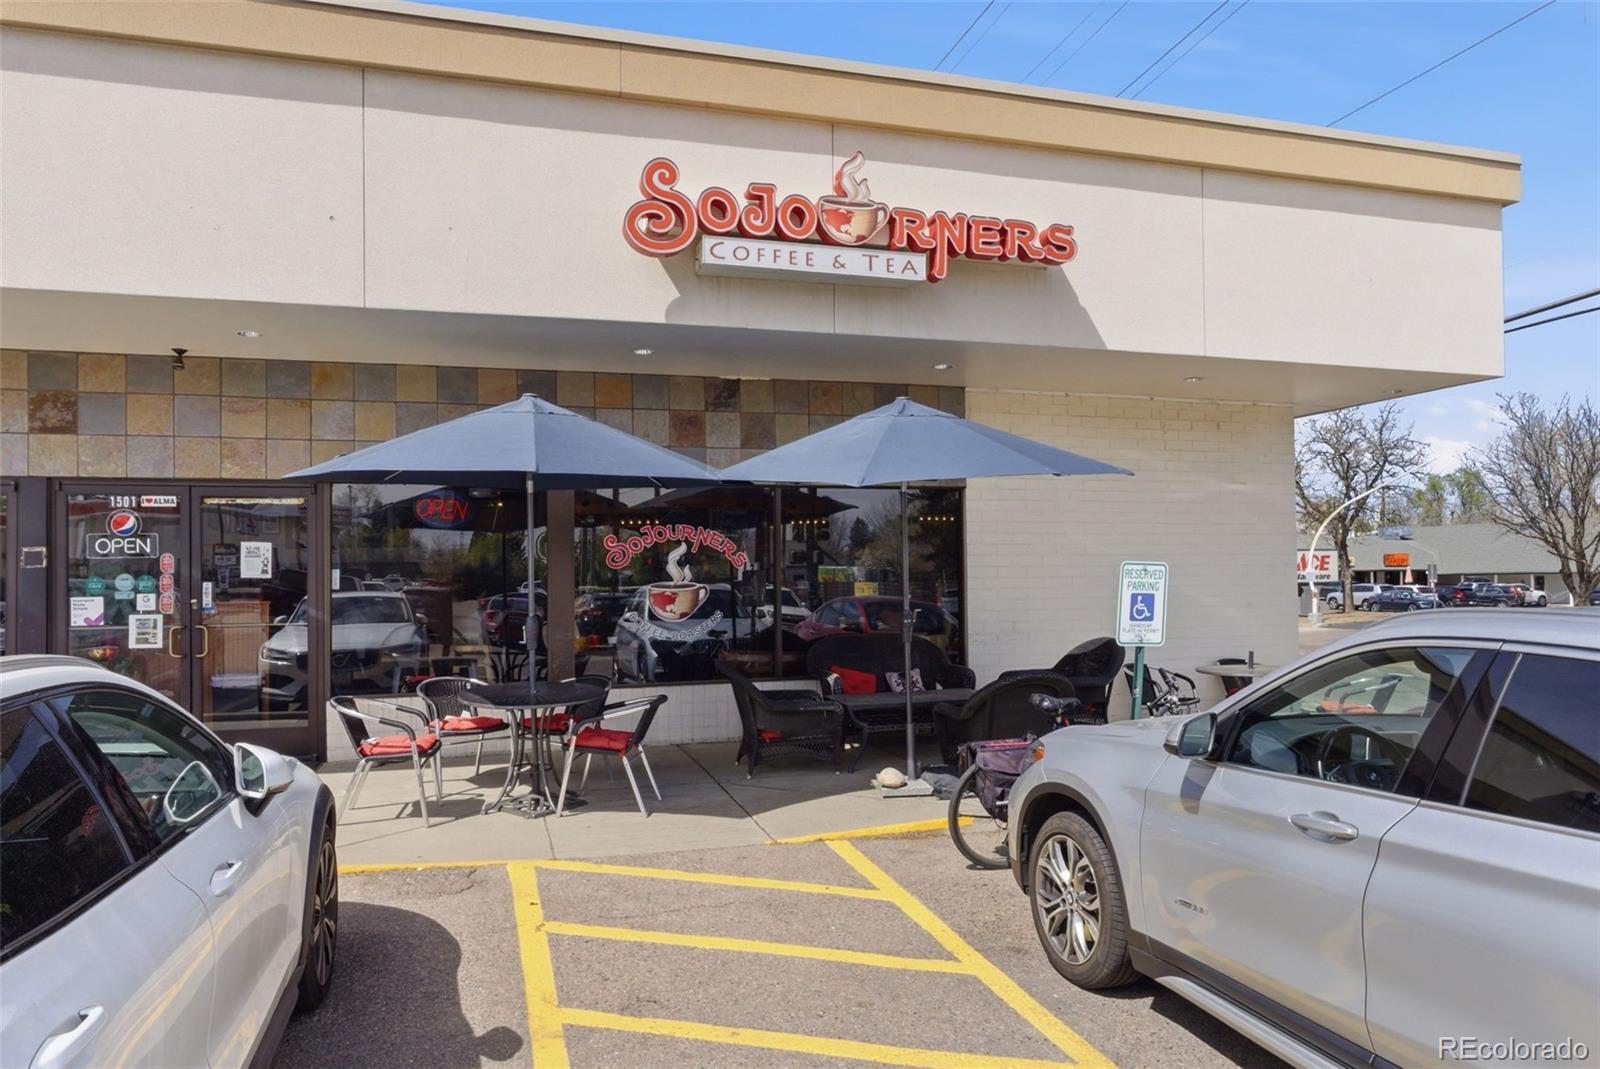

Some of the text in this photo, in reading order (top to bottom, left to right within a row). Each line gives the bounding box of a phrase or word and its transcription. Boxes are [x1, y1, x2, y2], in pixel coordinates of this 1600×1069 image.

[709, 241, 920, 276] COFFEE & TEA
[110, 496, 136, 507] 1501
[153, 497, 176, 505] ALMA
[415, 498, 470, 521] OPEN
[95, 538, 151, 554] OPEN
[1296, 553, 1331, 571] ACE
[1124, 568, 1164, 580] RESERVED
[1127, 581, 1160, 592] PARKING
[629, 609, 724, 641] COFFEE ROASTERS
